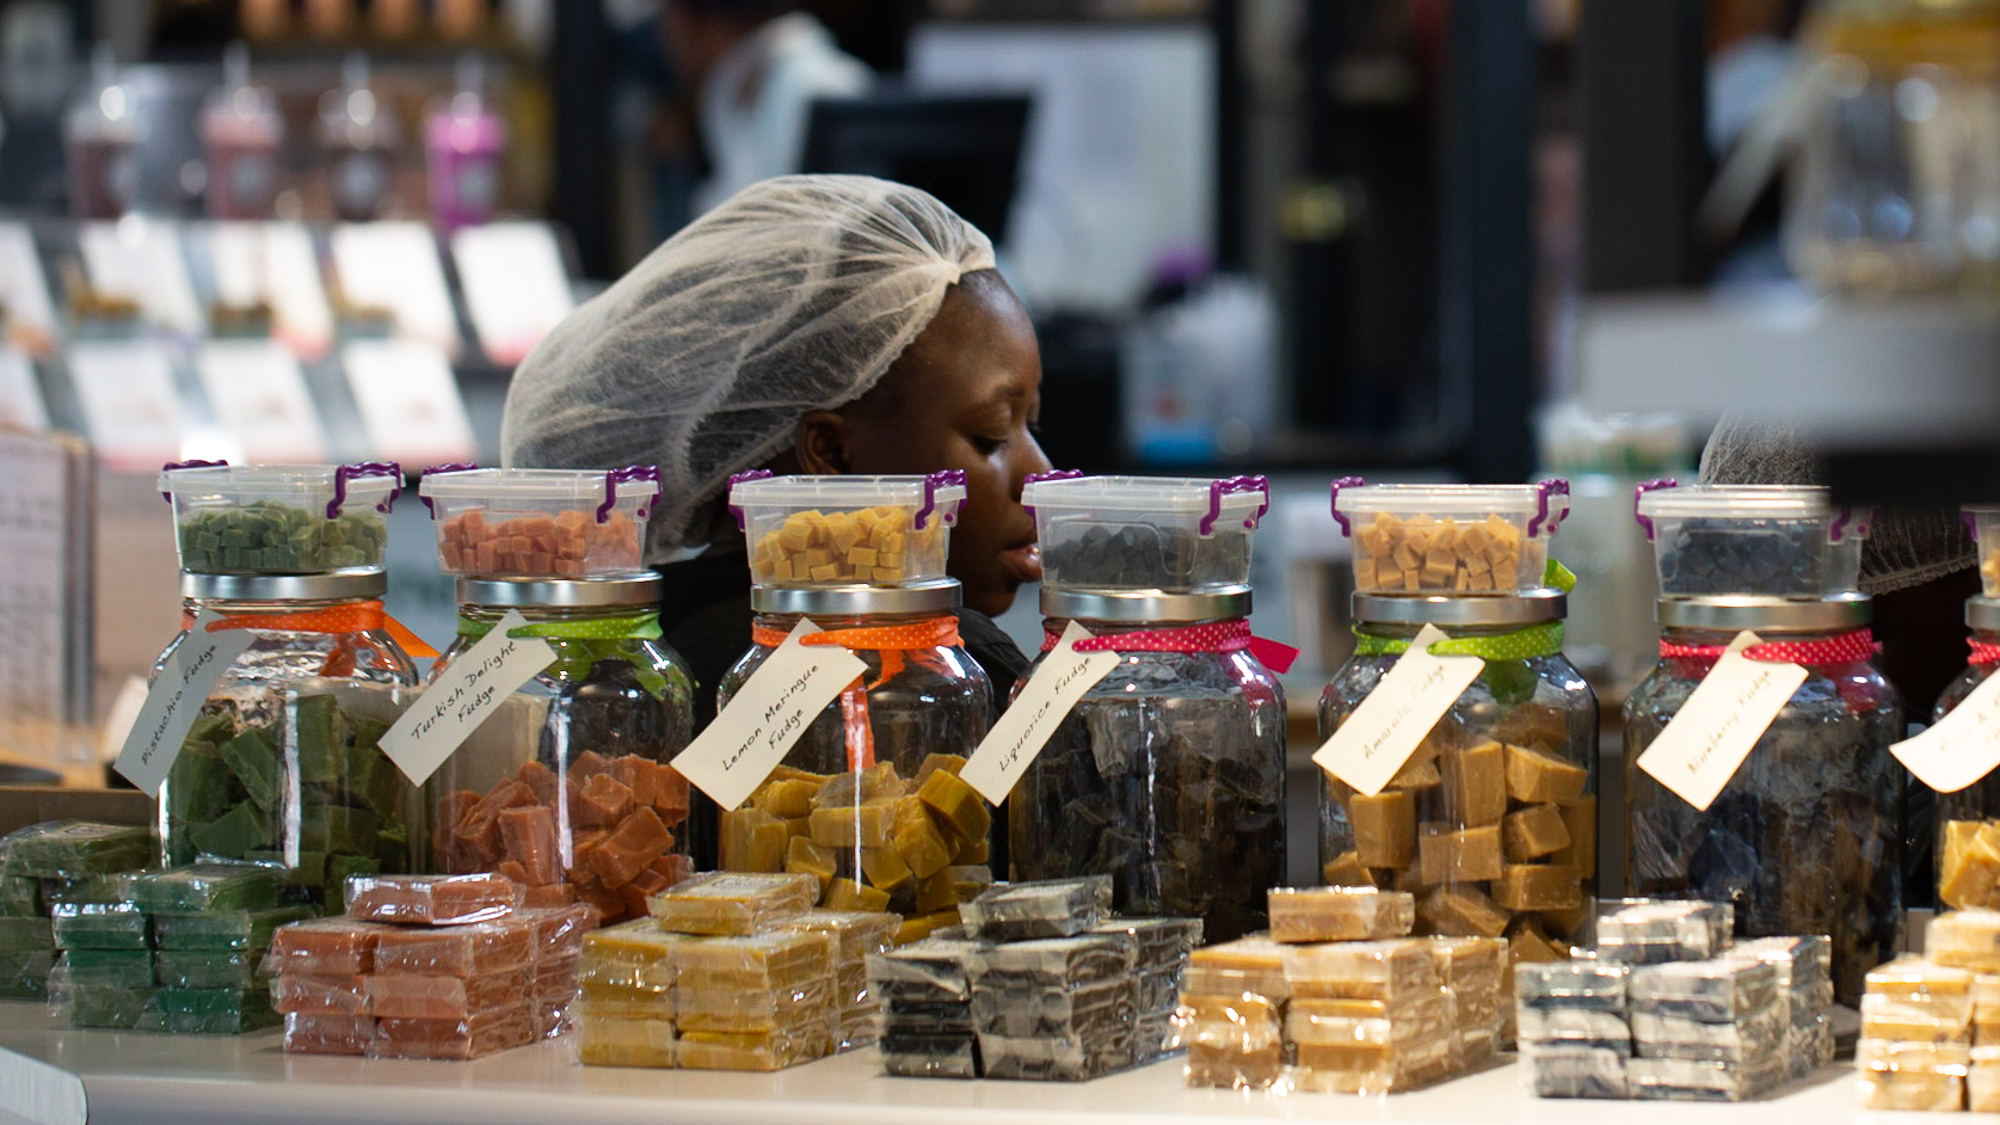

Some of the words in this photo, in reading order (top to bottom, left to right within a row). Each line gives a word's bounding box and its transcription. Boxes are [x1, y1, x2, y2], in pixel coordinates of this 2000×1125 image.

[141, 690, 183, 765] Pistachio
[183, 645, 216, 684] Fudge
[411, 687, 464, 740] Turkish
[465, 641, 517, 687] Delight
[457, 685, 496, 723] Fudge
[722, 727, 762, 771] Lemon
[764, 664, 819, 723] Meringue
[768, 708, 804, 750] Fudge
[999, 700, 1051, 772] Liquorice
[1054, 657, 1092, 695] Fudge
[1363, 705, 1412, 760] Amarula
[1410, 664, 1445, 702] Fudge
[1737, 670, 1771, 708] Fudge
